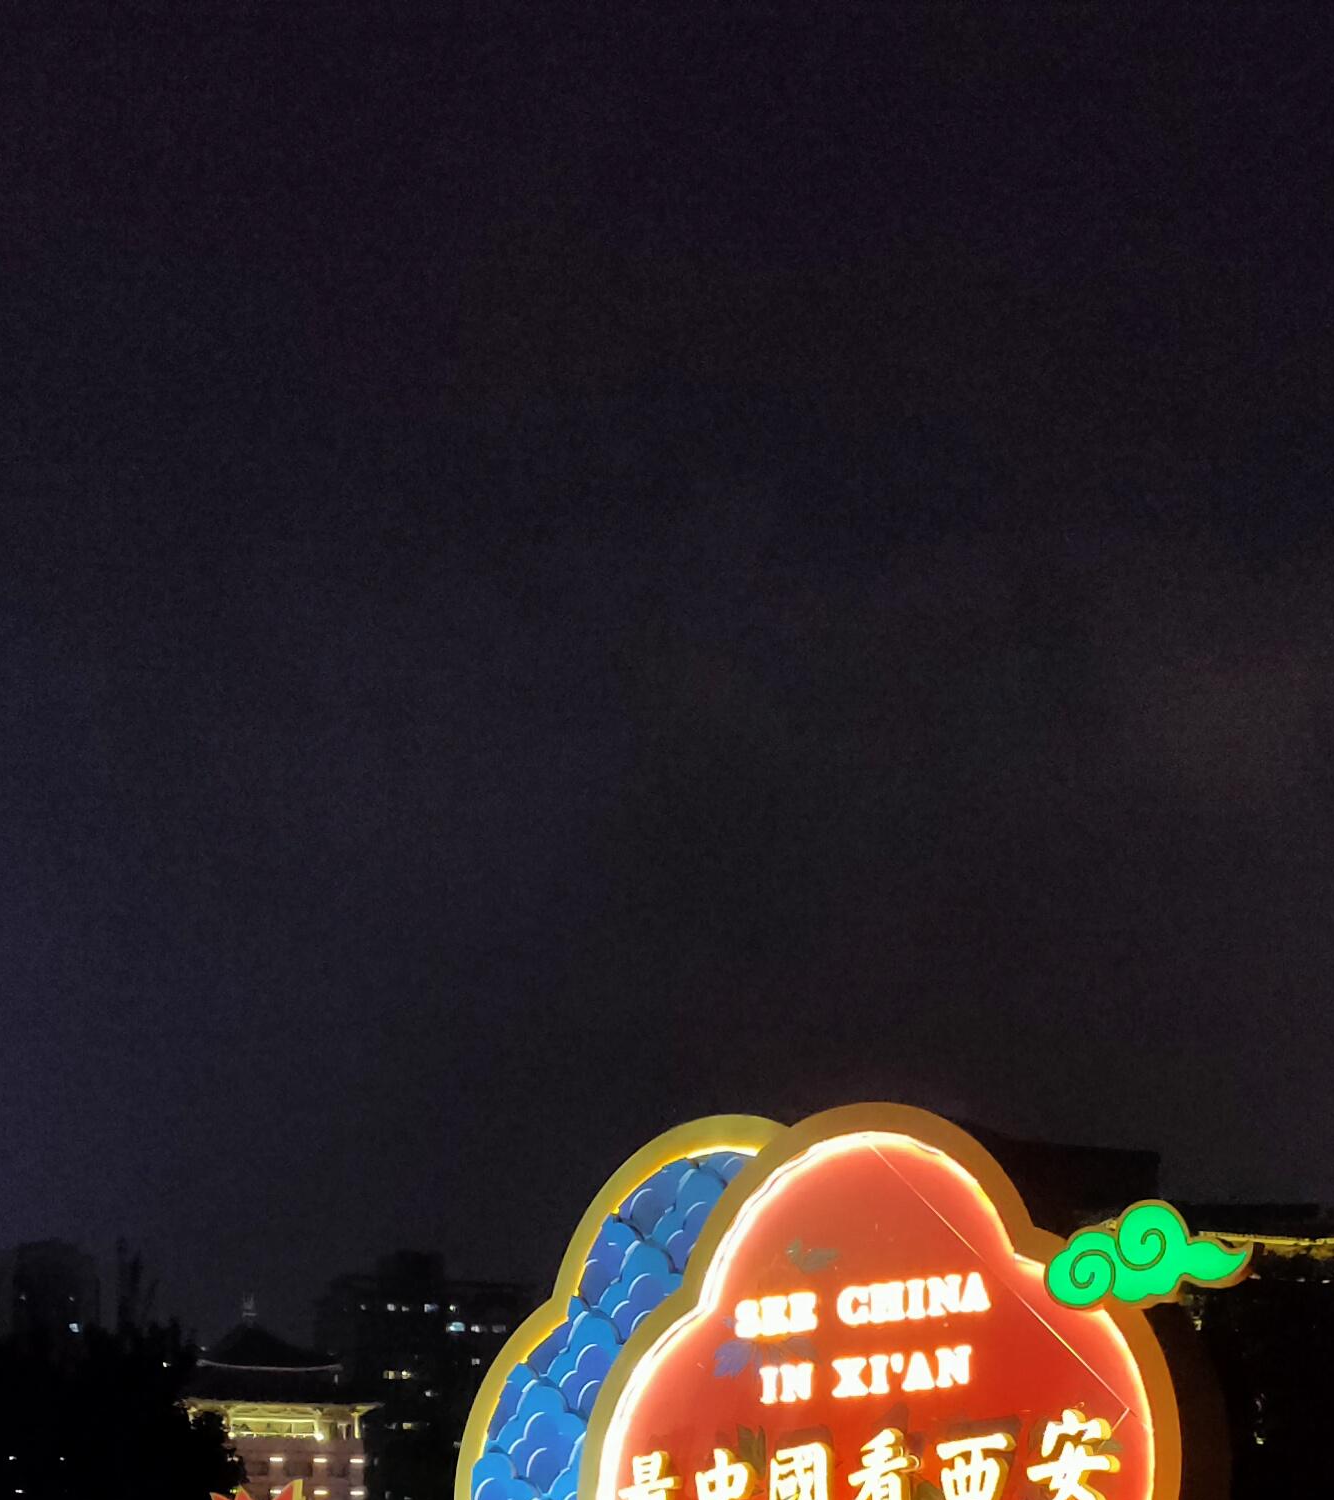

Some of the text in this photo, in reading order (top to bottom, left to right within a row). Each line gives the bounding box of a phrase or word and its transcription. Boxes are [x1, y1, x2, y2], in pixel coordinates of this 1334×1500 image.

[734, 1272, 992, 1339] SEE CHINA
[759, 1345, 972, 1404] IN XI'AN
